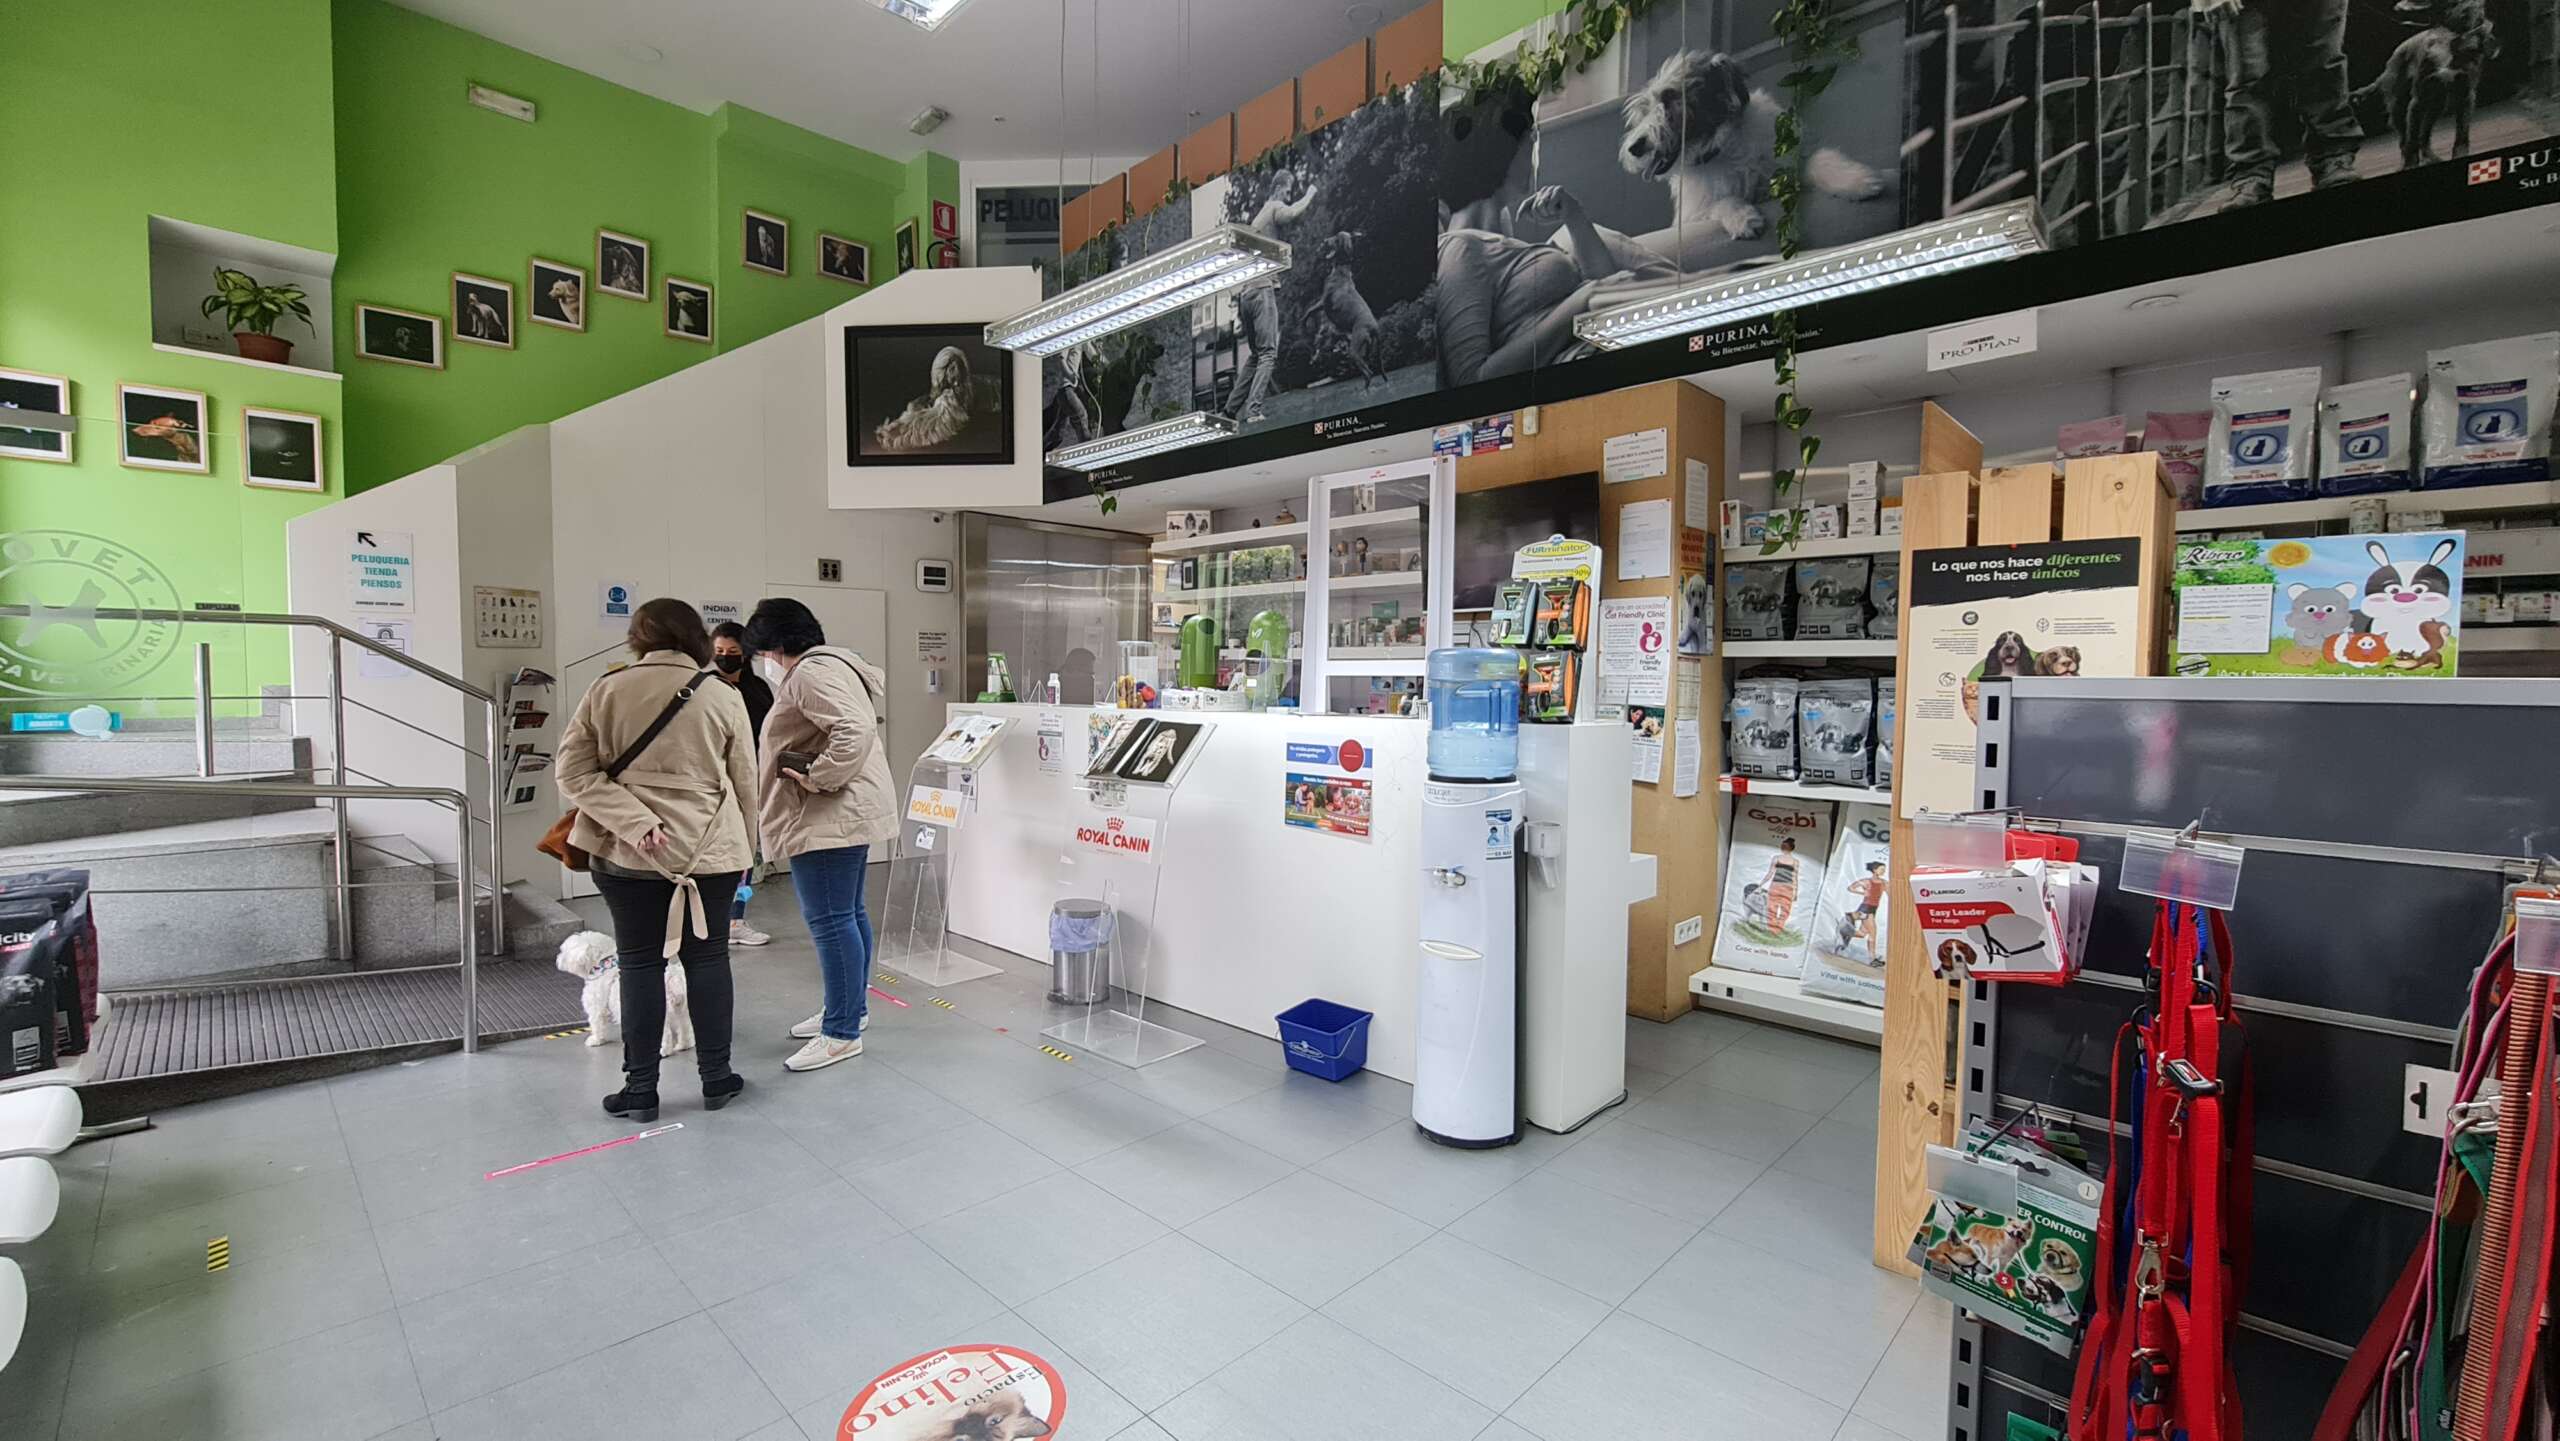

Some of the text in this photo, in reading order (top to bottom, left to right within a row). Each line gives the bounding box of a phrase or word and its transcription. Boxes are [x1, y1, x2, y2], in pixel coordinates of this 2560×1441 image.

[2508, 148, 2560, 173] PU
[2519, 172, 2560, 190] Su B
[1705, 322, 1769, 346] PURINA
[1940, 346, 1975, 360] PRO
[1323, 415, 1360, 431] PURINA
[351, 553, 410, 565] PELUQUERIA
[1931, 553, 2122, 573] Lo que nos hace diferentes
[2464, 553, 2504, 568] NIN
[364, 566, 398, 577] TIENDA
[1966, 567, 2081, 582] nos hace únicos
[360, 578, 402, 589] PIENSOS
[703, 604, 737, 613] INDIBA
[1604, 610, 1666, 620] Cat Friendly Clinic
[1748, 808, 1817, 828] Gosbi
[1858, 819, 1890, 844] Go
[1076, 827, 1151, 853] ROYAL CANIN
[1929, 908, 1986, 918] Easy Leader
[1839, 976, 1856, 985] with
[1858, 980, 1885, 991] salmo
[2016, 1206, 2088, 1243] ER CONTROL
[845, 1347, 1021, 1434] Felino
[963, 1365, 1045, 1407] Espacio
